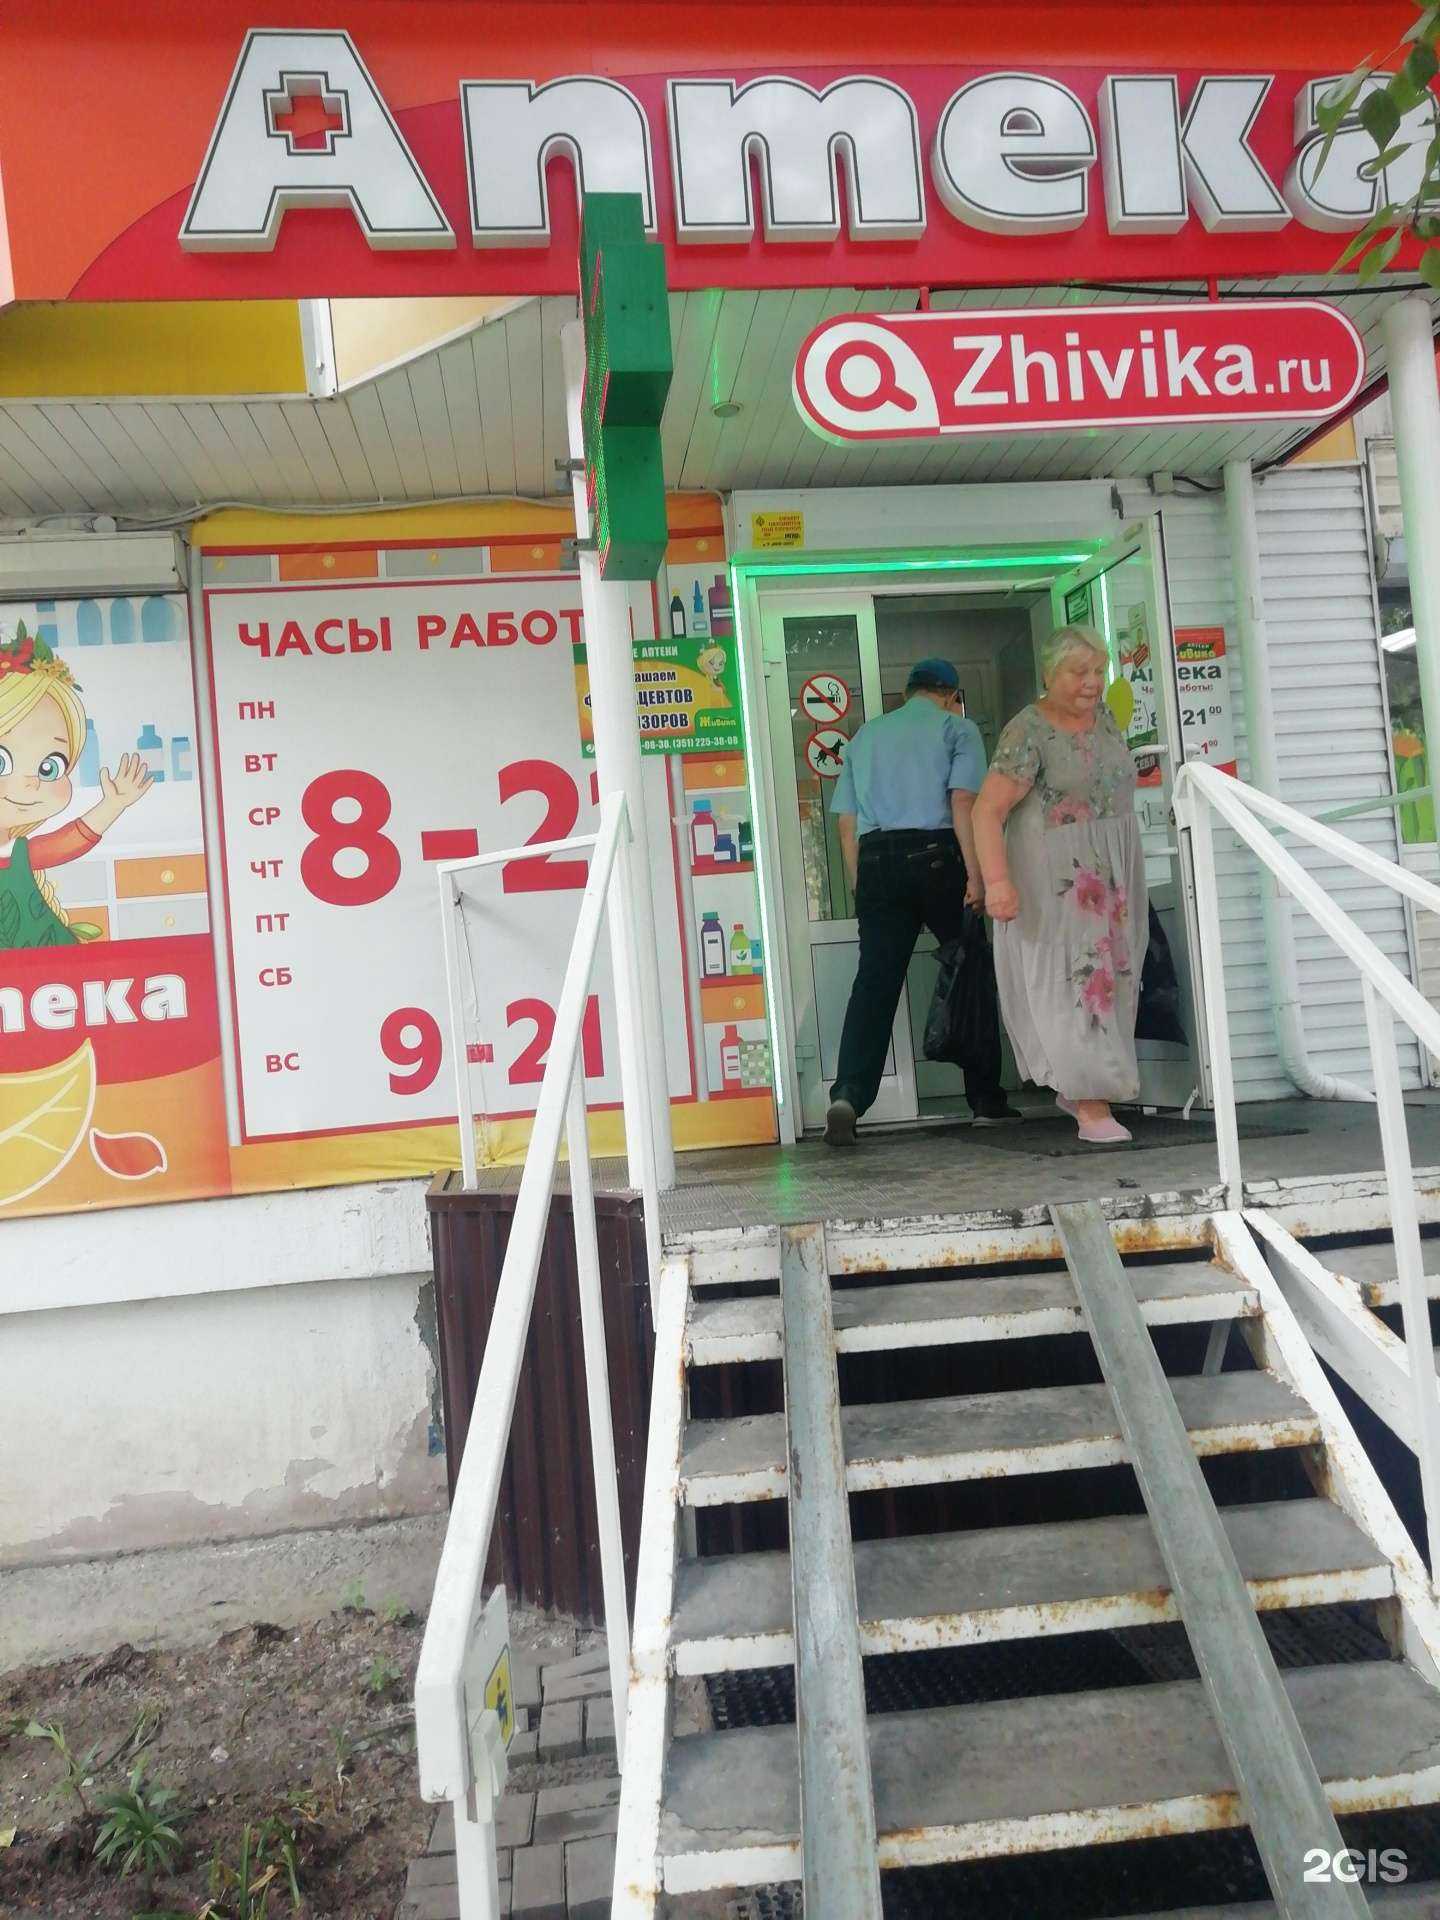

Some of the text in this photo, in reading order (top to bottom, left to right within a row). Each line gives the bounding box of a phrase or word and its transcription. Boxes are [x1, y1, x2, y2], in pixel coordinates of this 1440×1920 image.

[178, 28, 1440, 253] Аптека
[952, 328, 1332, 407] Zhivika.ru
[238, 605, 633, 658] ЧАСЫ РАБОТ
[238, 701, 276, 720] ПН
[244, 753, 278, 773] ВТ
[247, 807, 281, 826] СР
[250, 860, 284, 879] ЧТ
[255, 913, 290, 933] ПТ
[258, 967, 293, 987] СБ
[265, 1052, 300, 1073] ВС
